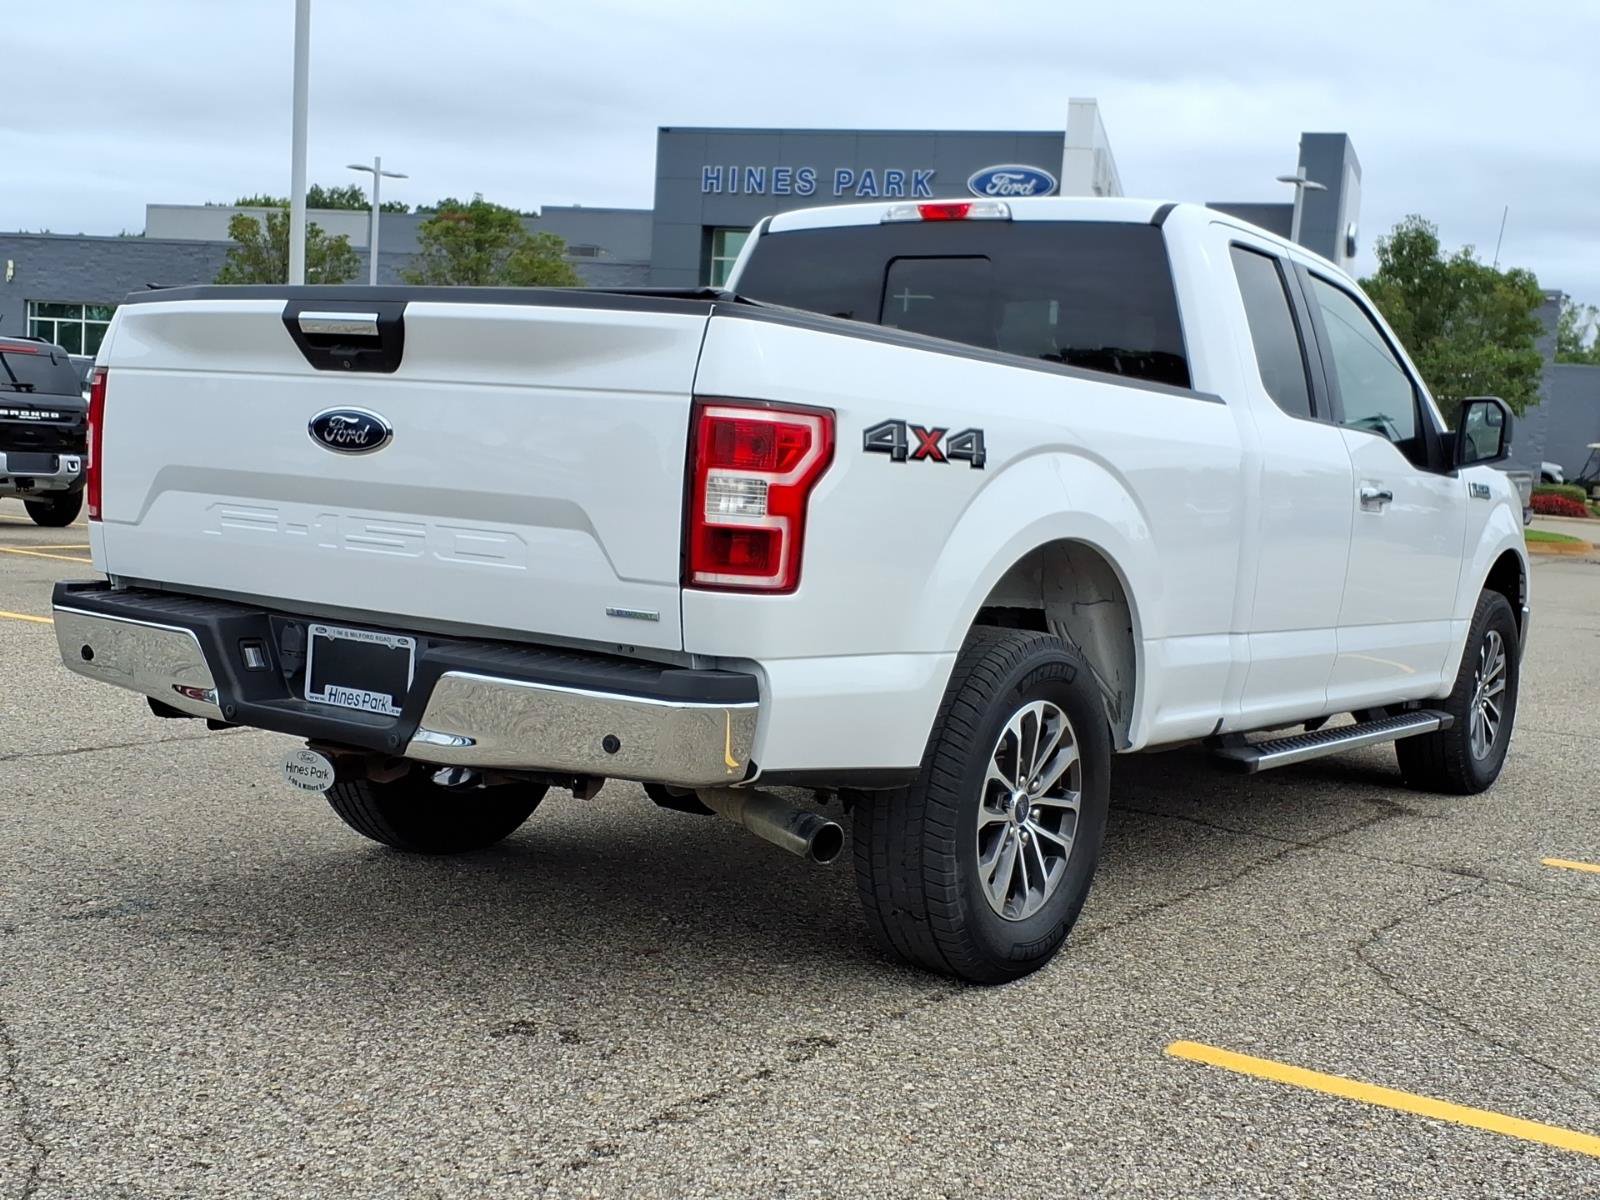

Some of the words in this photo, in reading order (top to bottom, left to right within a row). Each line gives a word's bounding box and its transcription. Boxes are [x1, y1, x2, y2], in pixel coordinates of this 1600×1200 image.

[702, 165, 816, 196] HINES
[834, 168, 936, 198] PARK
[986, 172, 1035, 197] Ford
[323, 414, 369, 444] Ford
[203, 502, 528, 570] F-150
[328, 687, 361, 708] Hines
[362, 693, 389, 713] Park
[285, 761, 310, 776] Hines
[310, 766, 330, 780] Park
